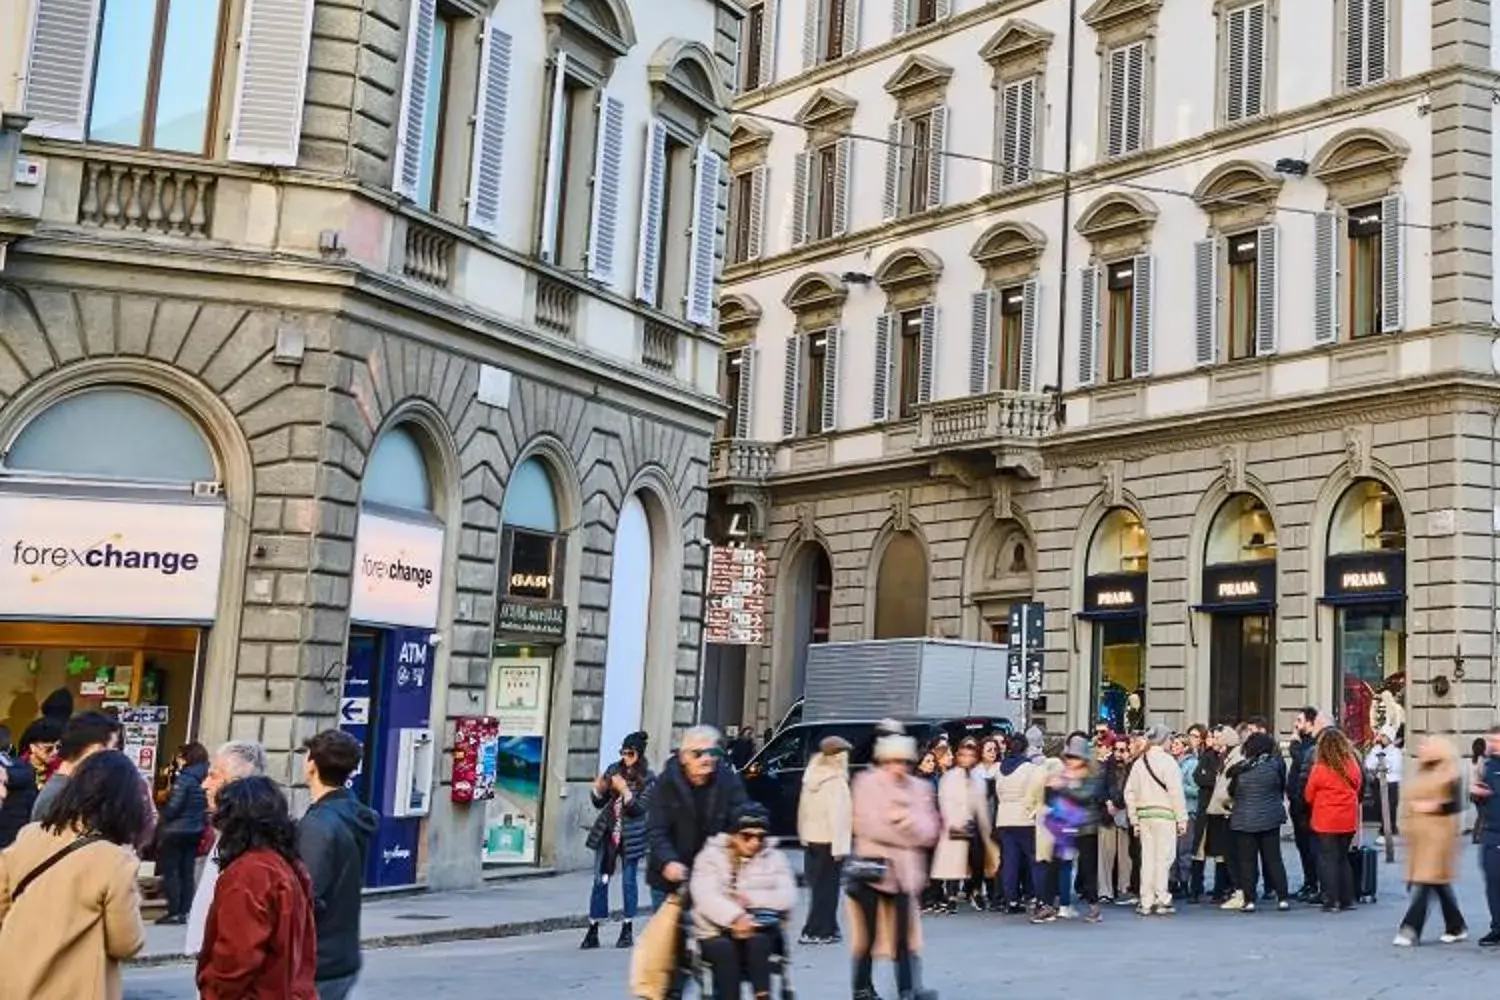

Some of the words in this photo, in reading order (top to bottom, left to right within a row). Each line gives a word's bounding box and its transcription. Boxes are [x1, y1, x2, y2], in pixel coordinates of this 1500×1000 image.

[13, 540, 199, 575] forexchange
[1343, 571, 1386, 587] PRADA
[1218, 581, 1258, 596] PRADA
[1097, 591, 1134, 605] PRADA
[400, 641, 427, 664] ATM
